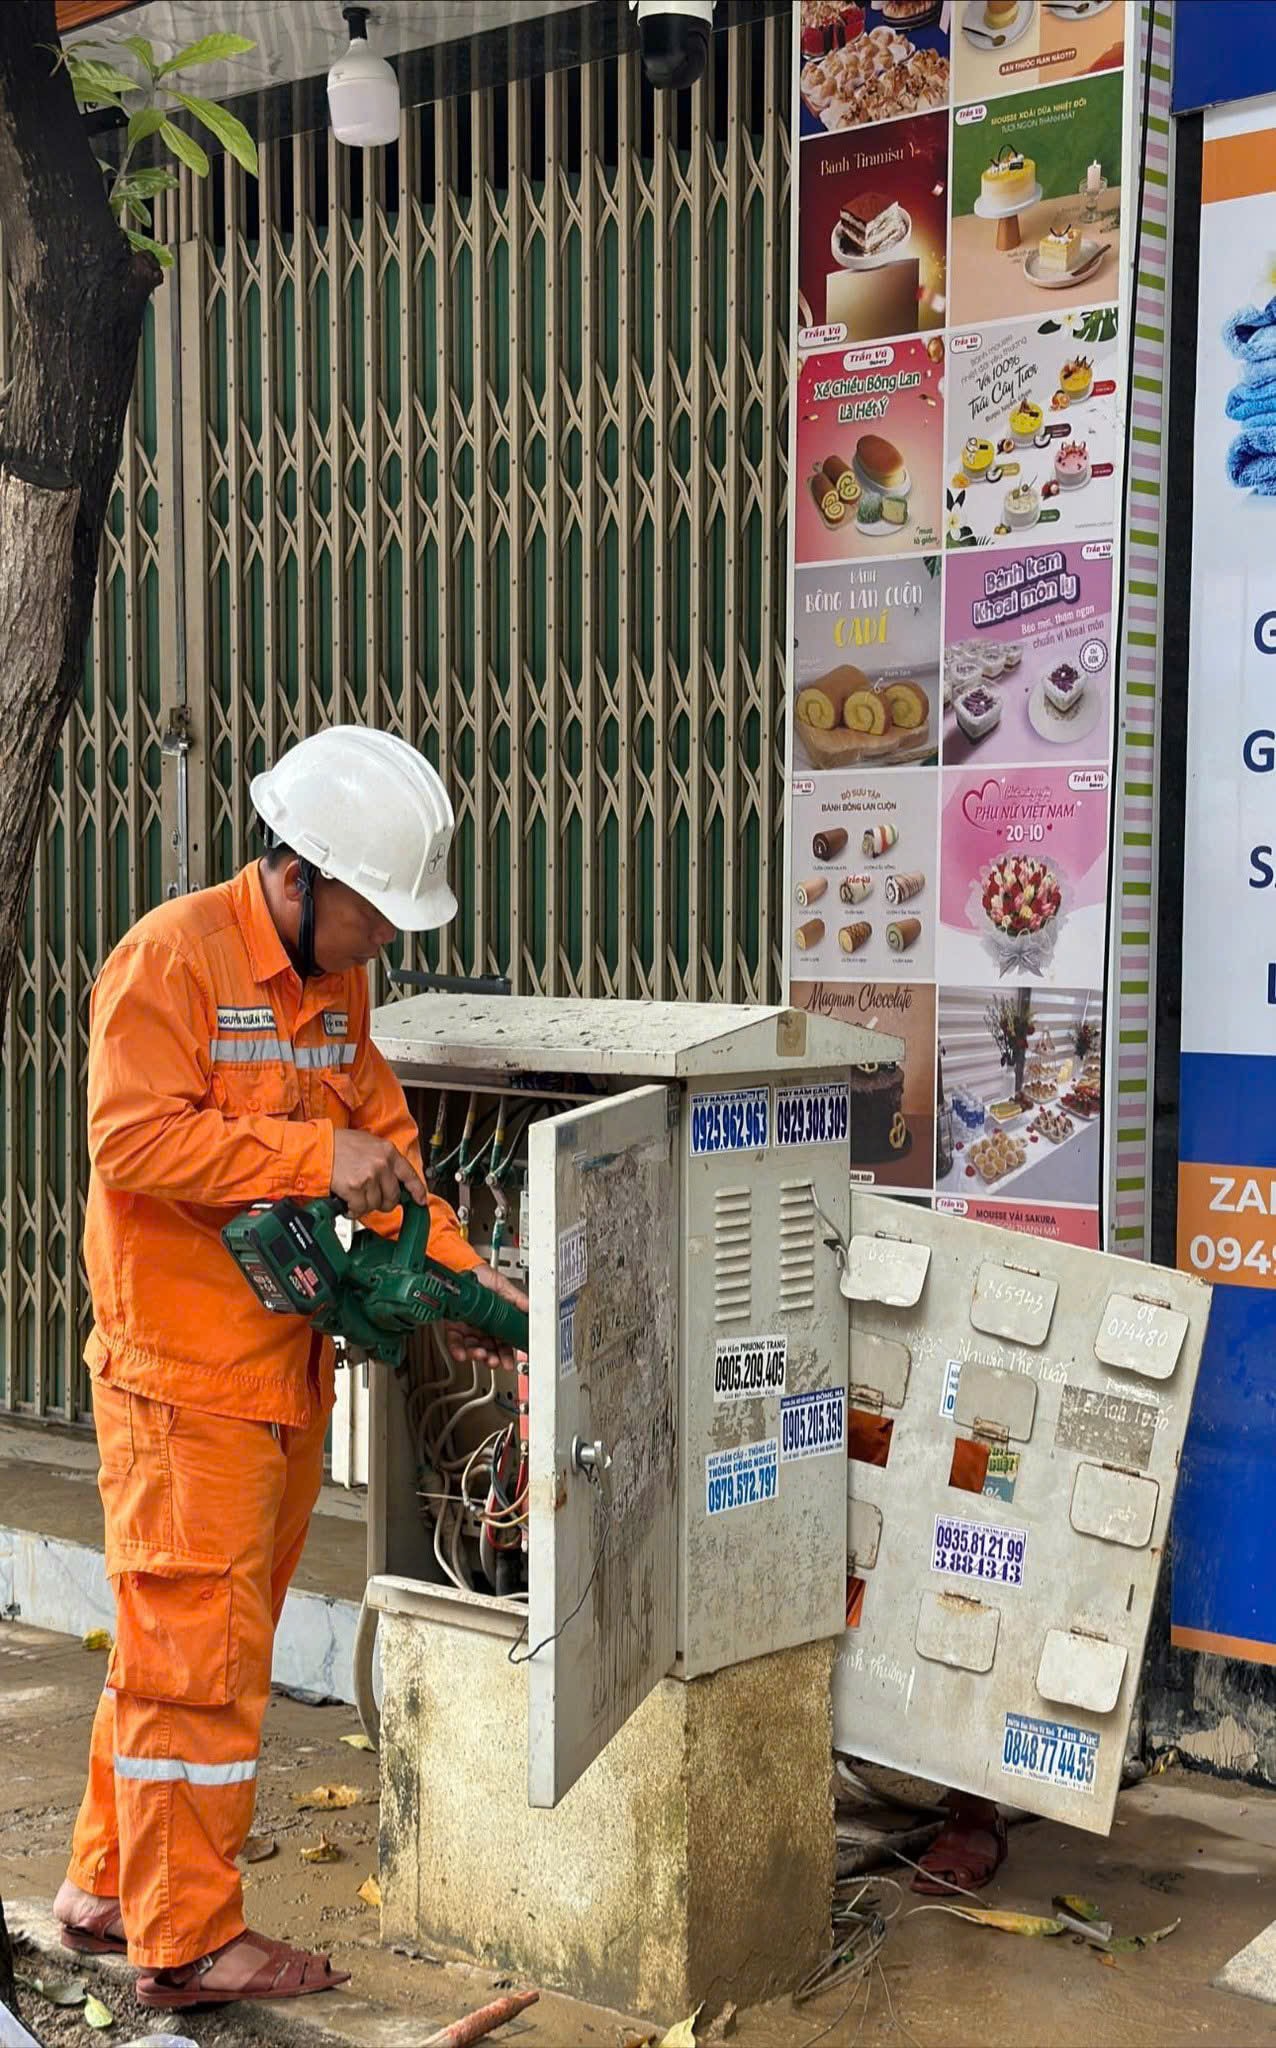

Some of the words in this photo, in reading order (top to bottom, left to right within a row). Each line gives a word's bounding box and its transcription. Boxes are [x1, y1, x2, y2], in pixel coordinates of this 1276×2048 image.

[804, 328, 826, 340] Trần
[849, 352, 871, 364] Trần
[873, 349, 888, 360] Vũ
[992, 355, 1020, 380] 100%
[866, 374, 897, 394] Bông
[898, 371, 920, 387] Lan
[838, 402, 855, 422] Là
[985, 563, 1024, 594] Bánh
[1026, 553, 1063, 584] kem
[973, 592, 1016, 624] Khoai
[1021, 580, 1058, 609] môn
[1059, 574, 1078, 600] ly
[1072, 773, 1092, 783] Trần
[1047, 804, 1075, 819] NAM
[1006, 824, 1045, 841] 20-10
[804, 982, 855, 1016] Magnum
[858, 984, 914, 1012] Chocolate
[693, 1101, 767, 1152] 0925.962.963
[777, 1096, 847, 1144] 0929.308.309
[976, 1210, 1007, 1221] MOUSSE
[1025, 1214, 1056, 1224] SAKURA
[1190, 1234, 1276, 1275] 094
[767, 1340, 786, 1350] TRANG
[1108, 1318, 1168, 1347] 074480
[715, 1351, 785, 1392] 0905.209.405
[783, 1399, 843, 1452] 0905.205.359
[708, 1465, 732, 1478] THÔNG
[708, 1465, 777, 1512] 0979.572.797
[937, 1525, 1023, 1563] 0935.81.21.99
[1004, 1728, 1096, 1784] 0848.77.44.55
